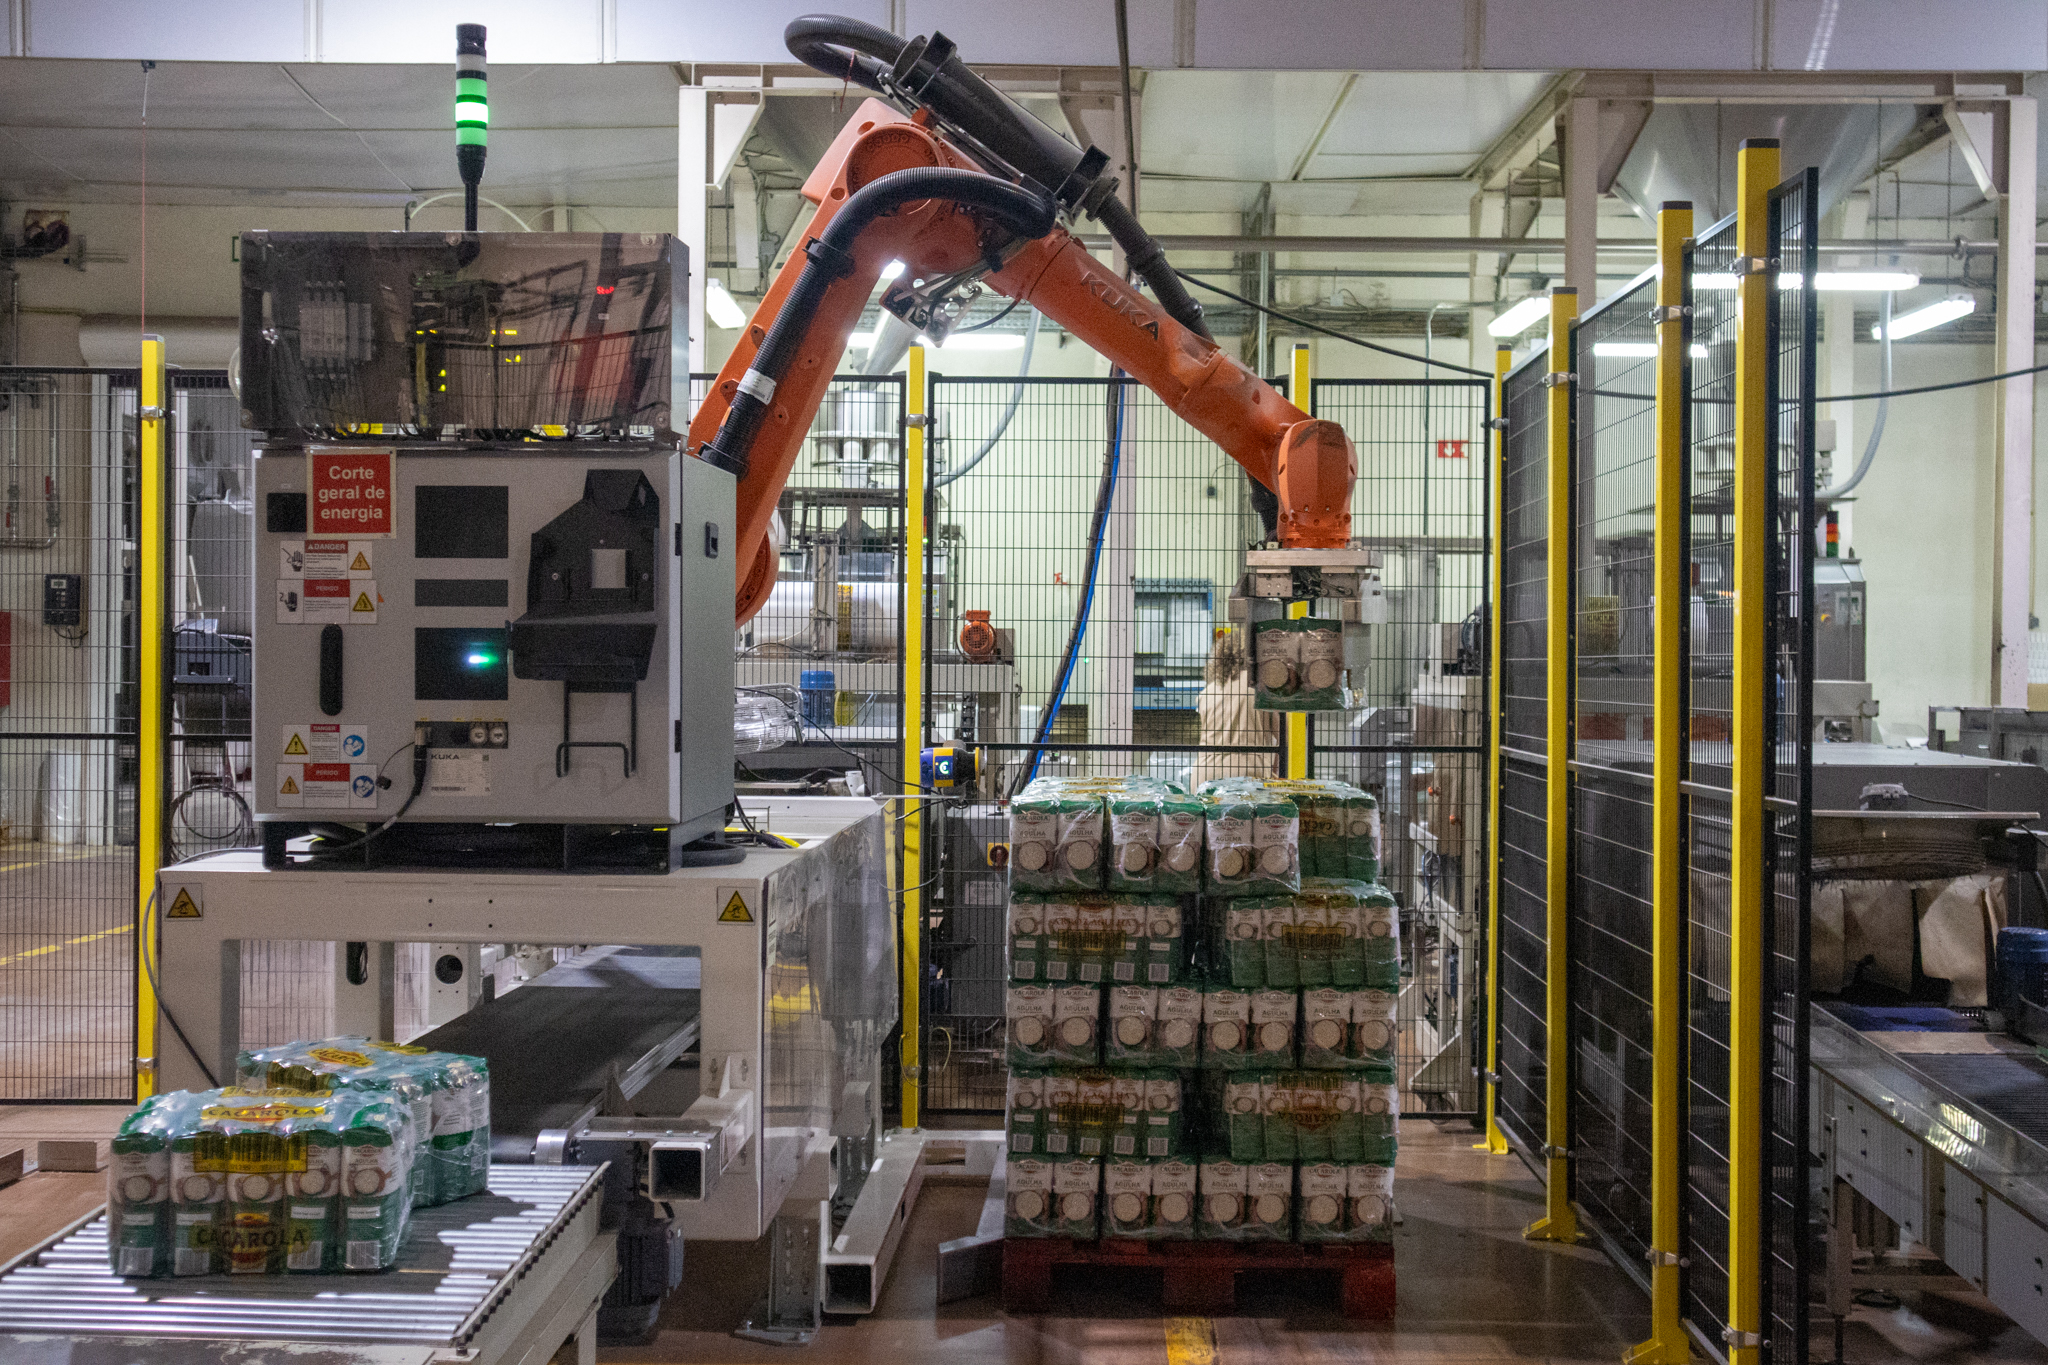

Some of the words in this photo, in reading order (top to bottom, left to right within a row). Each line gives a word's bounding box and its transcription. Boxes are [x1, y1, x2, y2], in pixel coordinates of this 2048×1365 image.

[1080, 270, 1159, 340] KUKA
[328, 465, 375, 480] Corte
[318, 485, 360, 503] geral
[365, 485, 385, 499] de
[320, 505, 383, 523] energia
